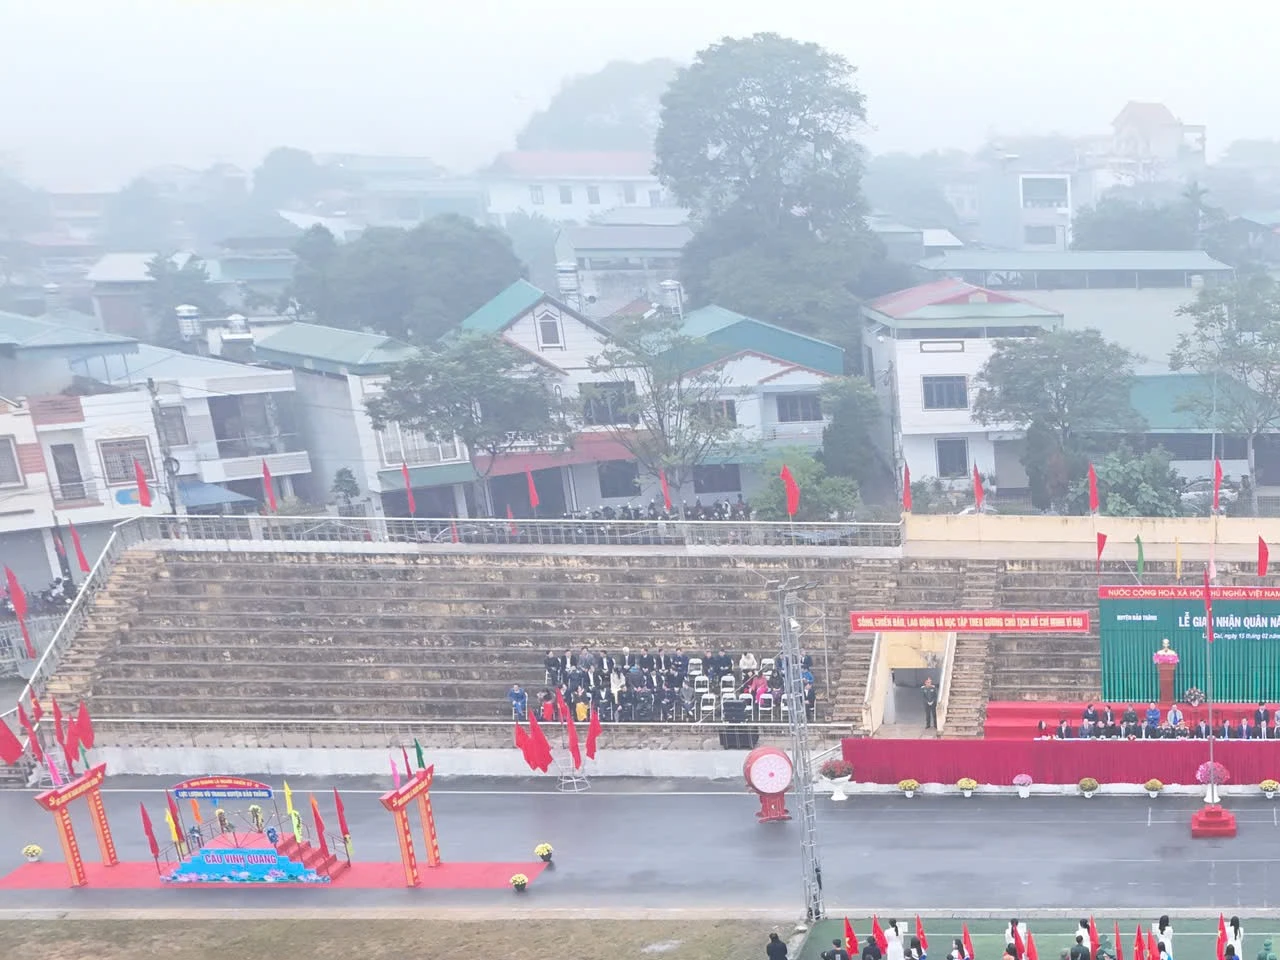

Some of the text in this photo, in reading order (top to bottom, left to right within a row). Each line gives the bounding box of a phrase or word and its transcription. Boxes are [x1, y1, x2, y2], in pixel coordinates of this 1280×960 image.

[1108, 588, 1131, 596] NƯỚC
[1132, 588, 1156, 597] CỘNG
[1190, 588, 1203, 597] HỘI
[1222, 589, 1247, 597] NGHĨA
[1249, 589, 1262, 598] VIỆT
[1178, 611, 1190, 627] LỄ
[1216, 614, 1241, 629] NHẬN
[1243, 614, 1268, 629] QUÂN
[224, 854, 245, 864] VINH
[247, 854, 277, 864] QUANG
